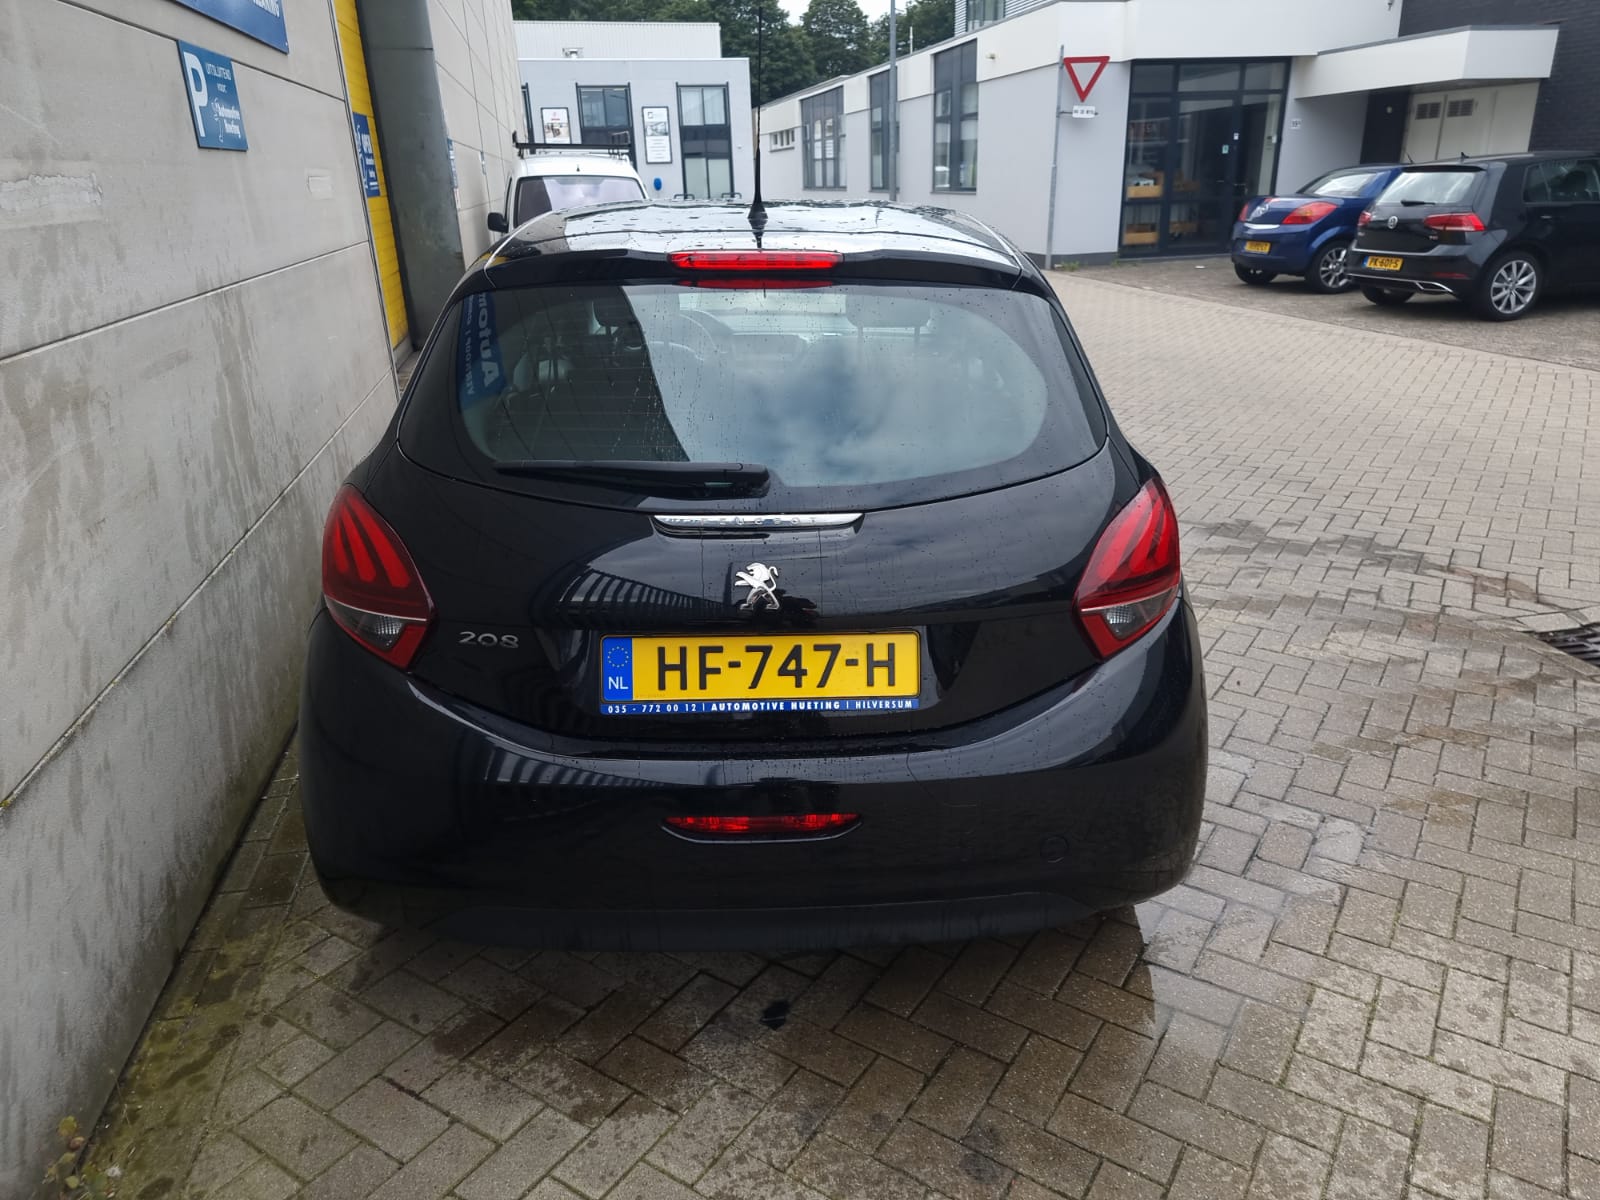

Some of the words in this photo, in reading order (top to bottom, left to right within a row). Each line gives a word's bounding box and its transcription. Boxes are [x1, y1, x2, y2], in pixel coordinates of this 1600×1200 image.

[183, 51, 208, 137] P
[459, 631, 519, 648] 208
[657, 642, 895, 691] HF-747-H
[608, 676, 629, 690] NL
[608, 704, 627, 714] 035
[642, 703, 661, 713] 772
[666, 704, 679, 712] 00
[685, 702, 697, 712] 12
[711, 701, 784, 711] AUTOMOTIVE
[791, 701, 840, 710] HUETING
[855, 700, 913, 710] HILVERSUM
